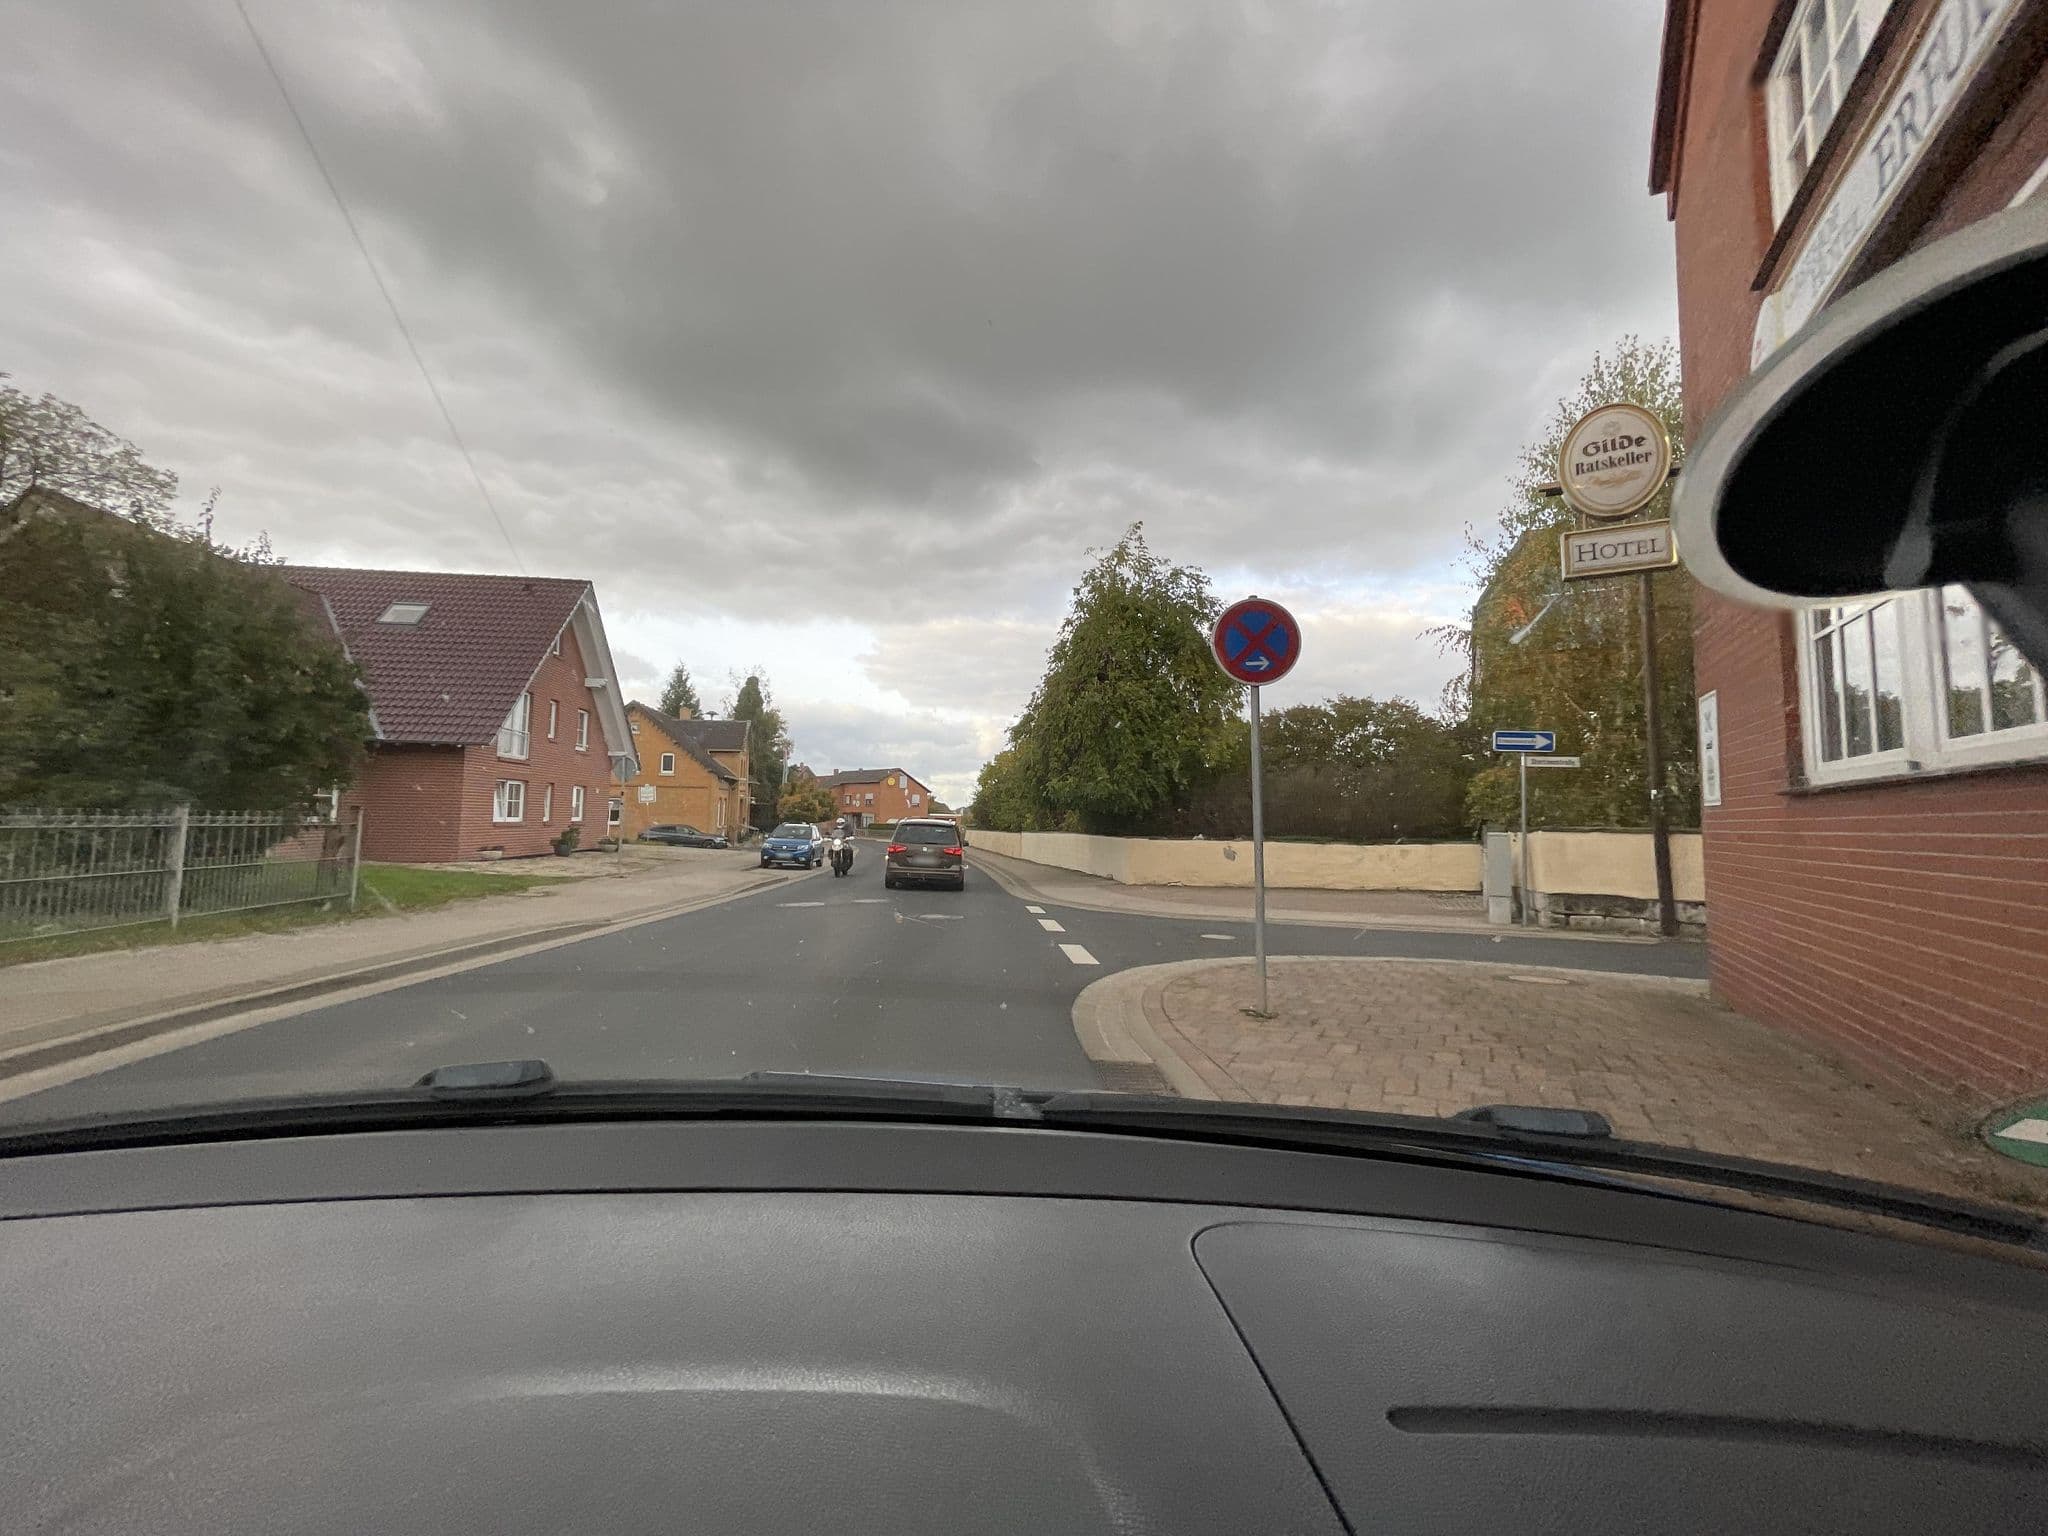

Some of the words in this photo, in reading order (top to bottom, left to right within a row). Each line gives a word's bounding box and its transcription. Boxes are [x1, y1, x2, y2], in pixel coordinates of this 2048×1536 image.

[1870, 0, 1992, 206] ERFU
[1575, 451, 1653, 476] Ratskeller
[1575, 538, 1663, 563] HOTEL
